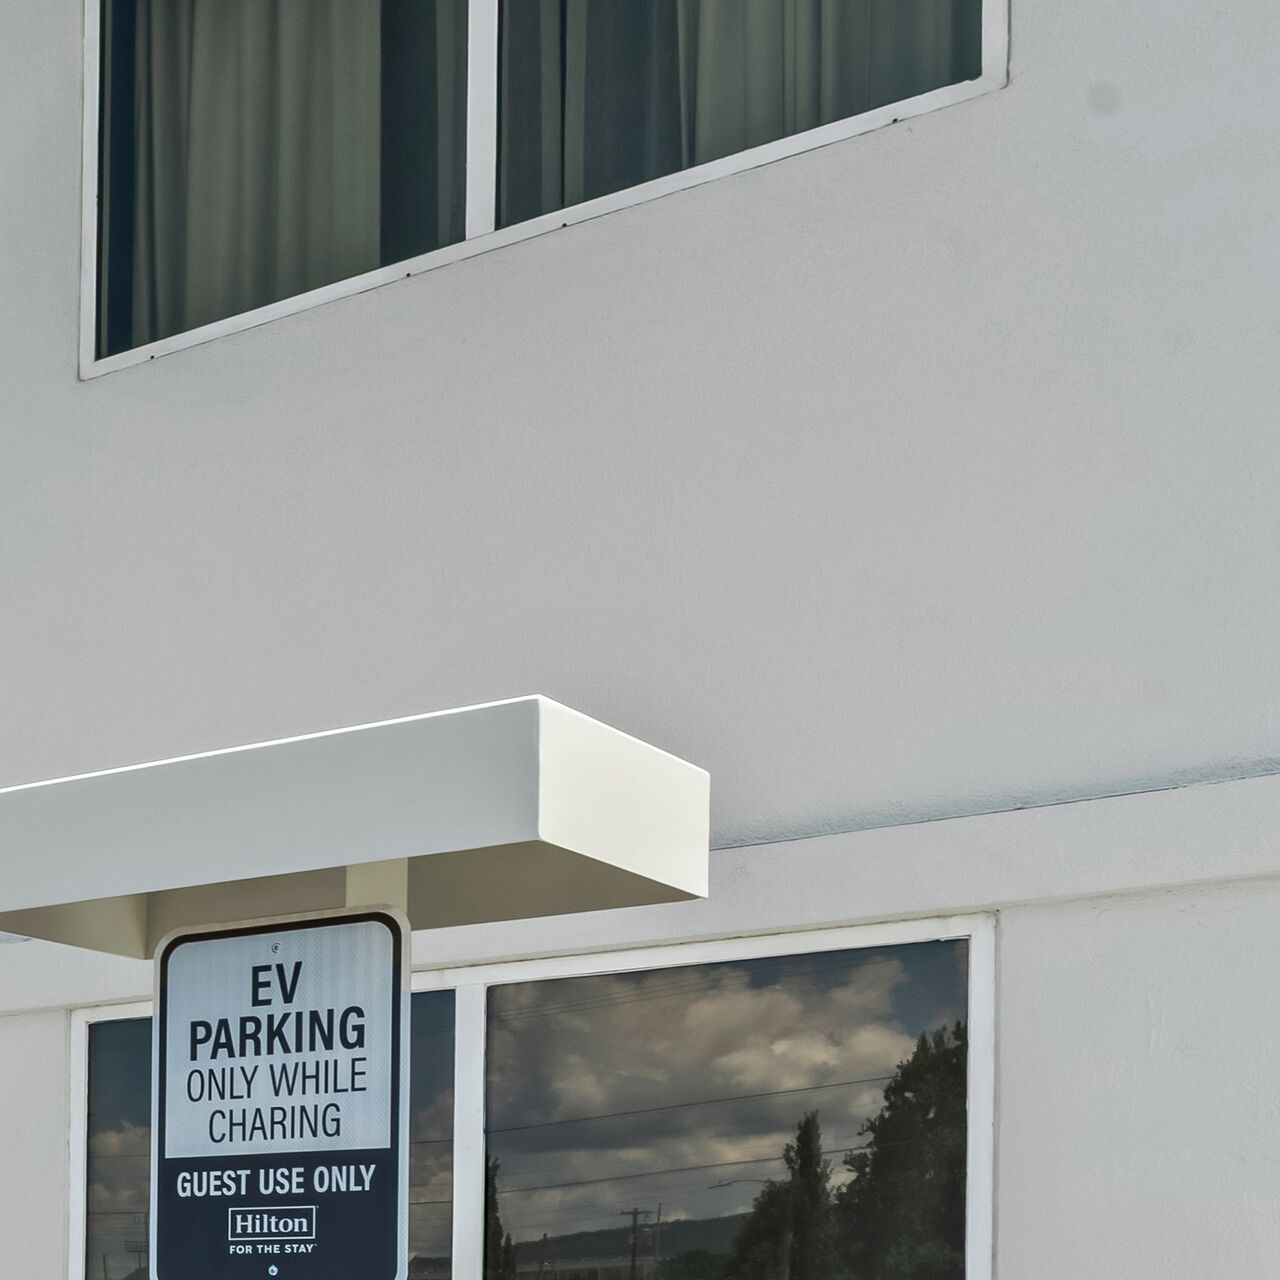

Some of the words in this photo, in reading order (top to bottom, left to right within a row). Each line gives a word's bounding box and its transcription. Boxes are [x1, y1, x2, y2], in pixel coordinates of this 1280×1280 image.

[251, 961, 303, 1007] EV
[190, 1006, 365, 1061] PARKING
[187, 1065, 259, 1102] ONLY
[269, 1057, 367, 1097] WHILE
[209, 1103, 341, 1143] CHARING
[177, 1170, 251, 1198] GUEST
[259, 1167, 305, 1195] USE
[313, 1164, 376, 1193] ONLY
[235, 1214, 309, 1234] Hilton
[229, 1245, 253, 1255] FOR
[256, 1244, 281, 1254] THE
[284, 1243, 314, 1254] STAY
